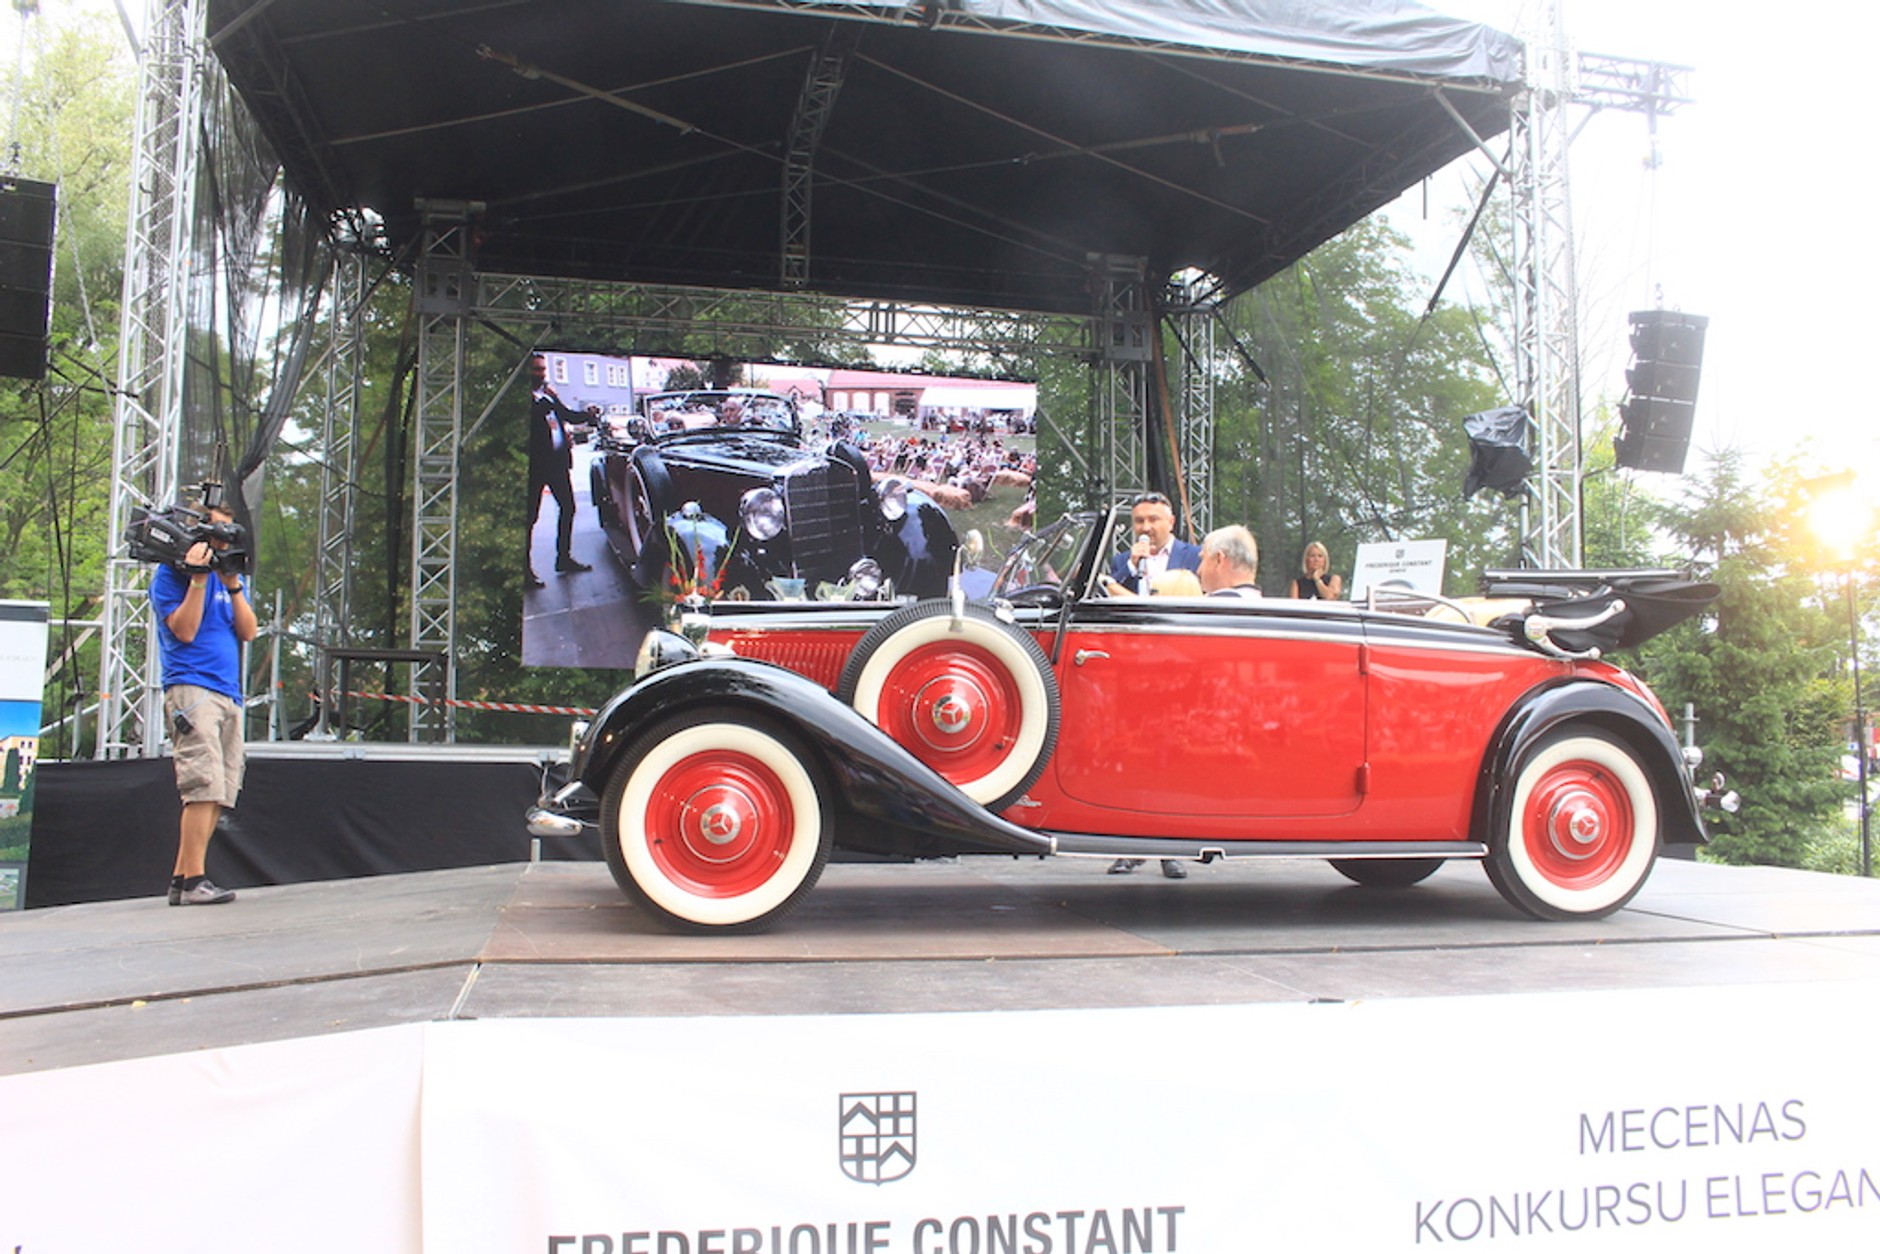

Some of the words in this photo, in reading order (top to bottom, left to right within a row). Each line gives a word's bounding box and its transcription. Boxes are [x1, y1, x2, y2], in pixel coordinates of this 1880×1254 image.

[1579, 1099, 1807, 1155] MECENAS
[912, 1205, 1186, 1254] CONSTANT
[1415, 1179, 1687, 1245] KONKURSU
[1706, 1168, 1880, 1219] ELEGAN
